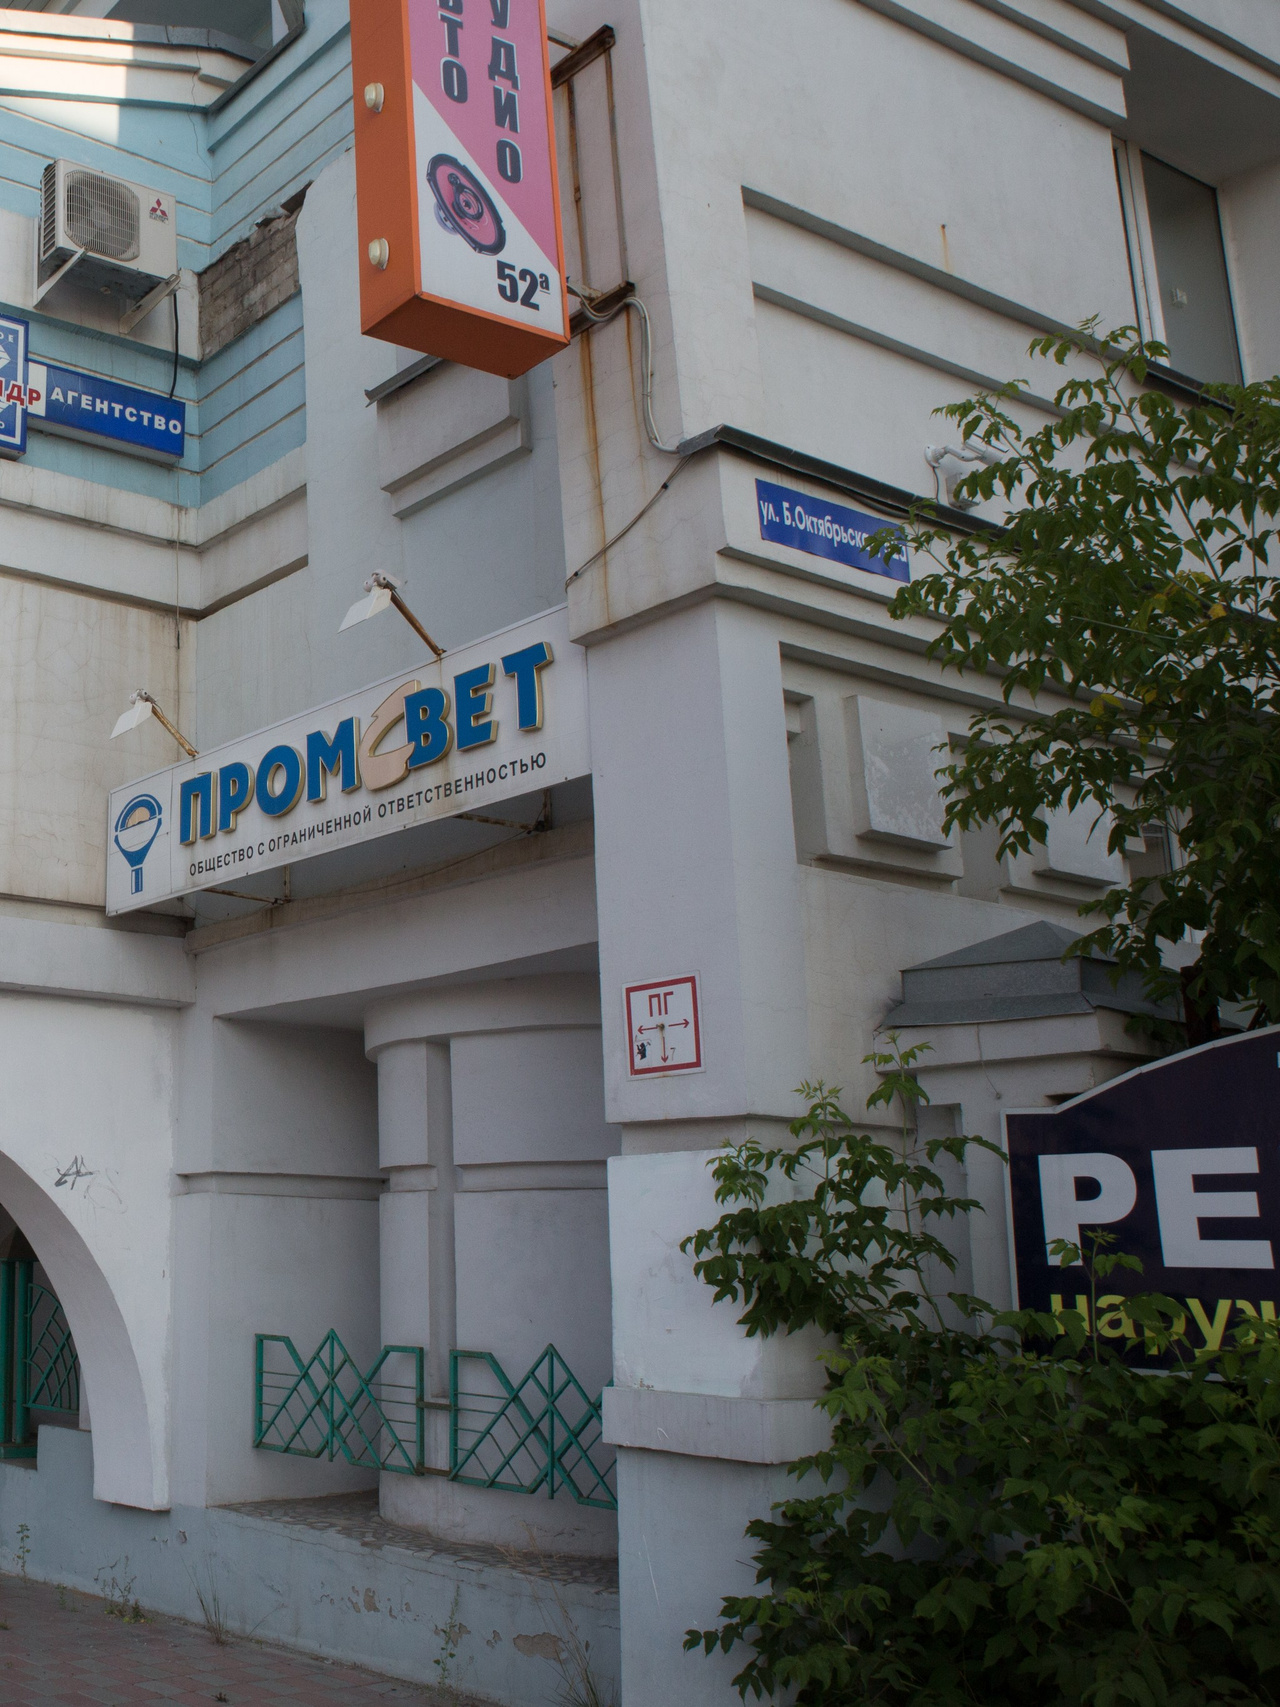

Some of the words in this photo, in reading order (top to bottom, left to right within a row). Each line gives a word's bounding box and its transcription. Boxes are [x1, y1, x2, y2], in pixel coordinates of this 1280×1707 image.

[50, 386, 183, 435] АГЕНТСТВО
[760, 500, 780, 525] ул.
[180, 641, 554, 846] ПРОМСВЕТ
[189, 845, 254, 877] ОБЩЕСТВО
[257, 842, 265, 856] С
[269, 805, 371, 852] ОГРАНИЧЕННОЙ
[377, 752, 547, 818] ОТВЕТСТВЕННОСТЬЮ
[648, 991, 674, 1017] ПГ
